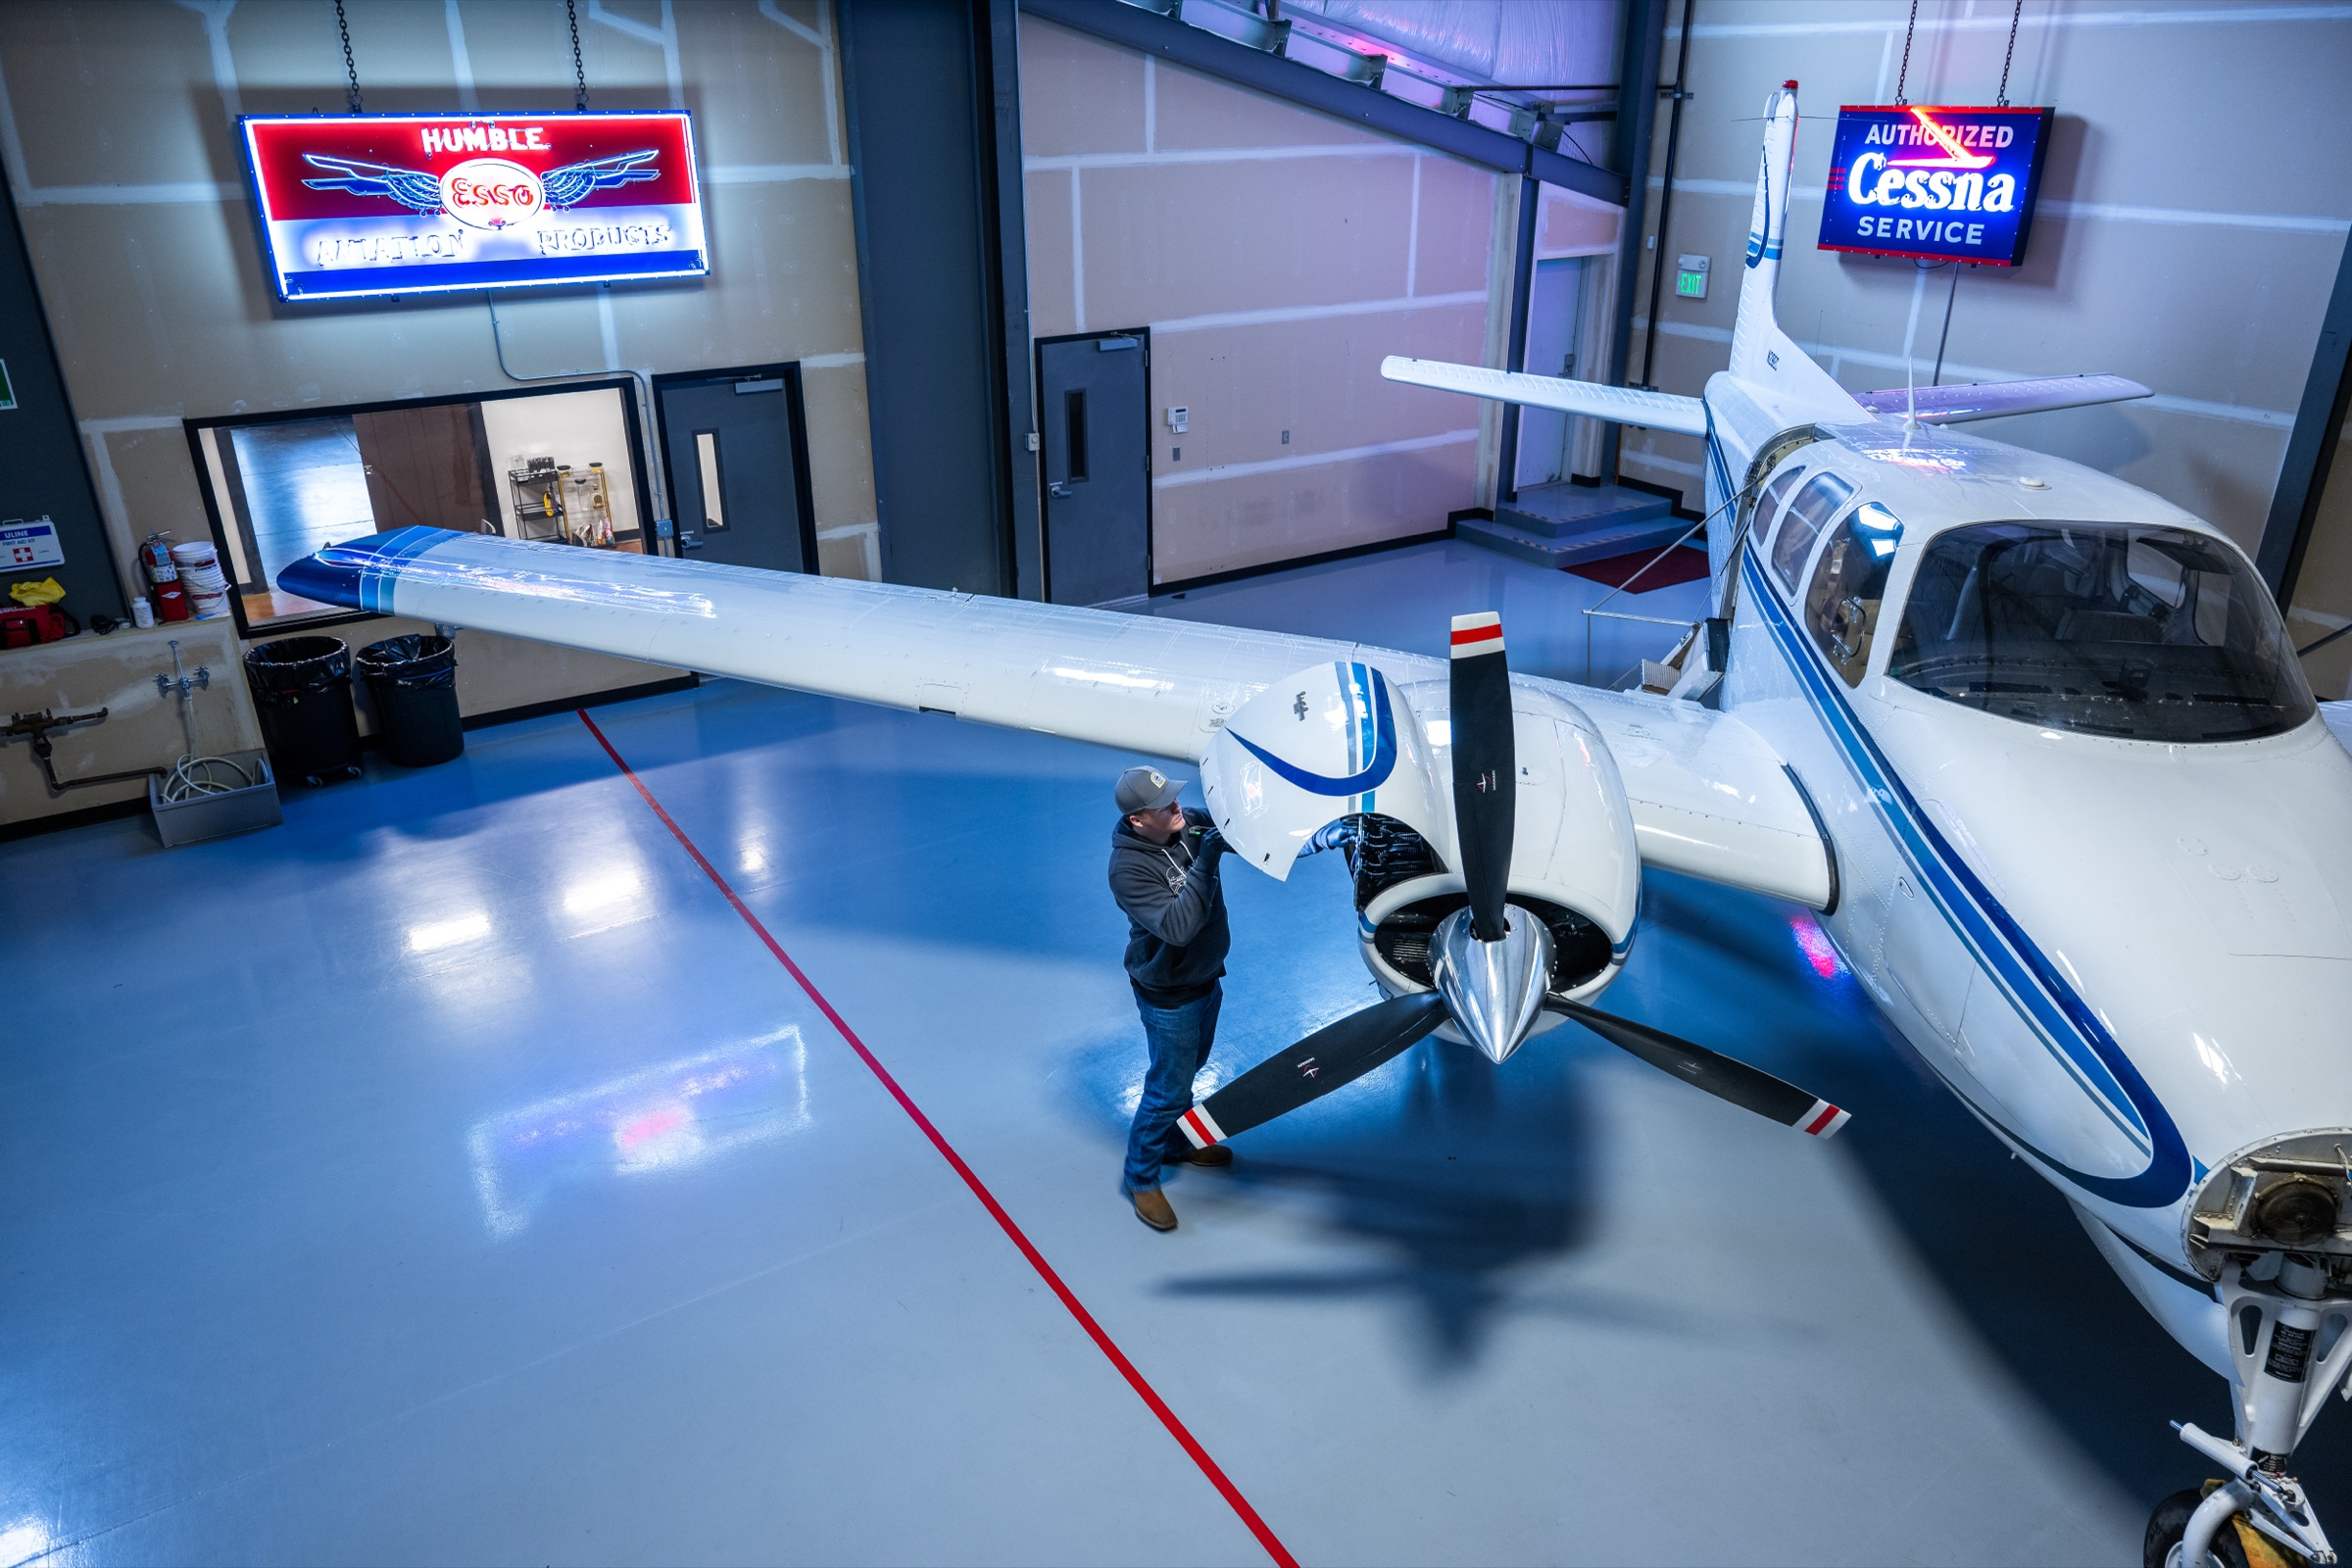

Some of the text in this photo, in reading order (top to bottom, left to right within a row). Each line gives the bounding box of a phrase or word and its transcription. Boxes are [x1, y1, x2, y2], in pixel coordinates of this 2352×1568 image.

[420, 126, 548, 153] HUMBLE
[1848, 151, 2016, 213] Cessna
[536, 224, 671, 251] PRODUCTS
[1857, 216, 1985, 245] SERVICE
[1681, 272, 1702, 294] EXIT
[4, 529, 28, 539] ULINE
